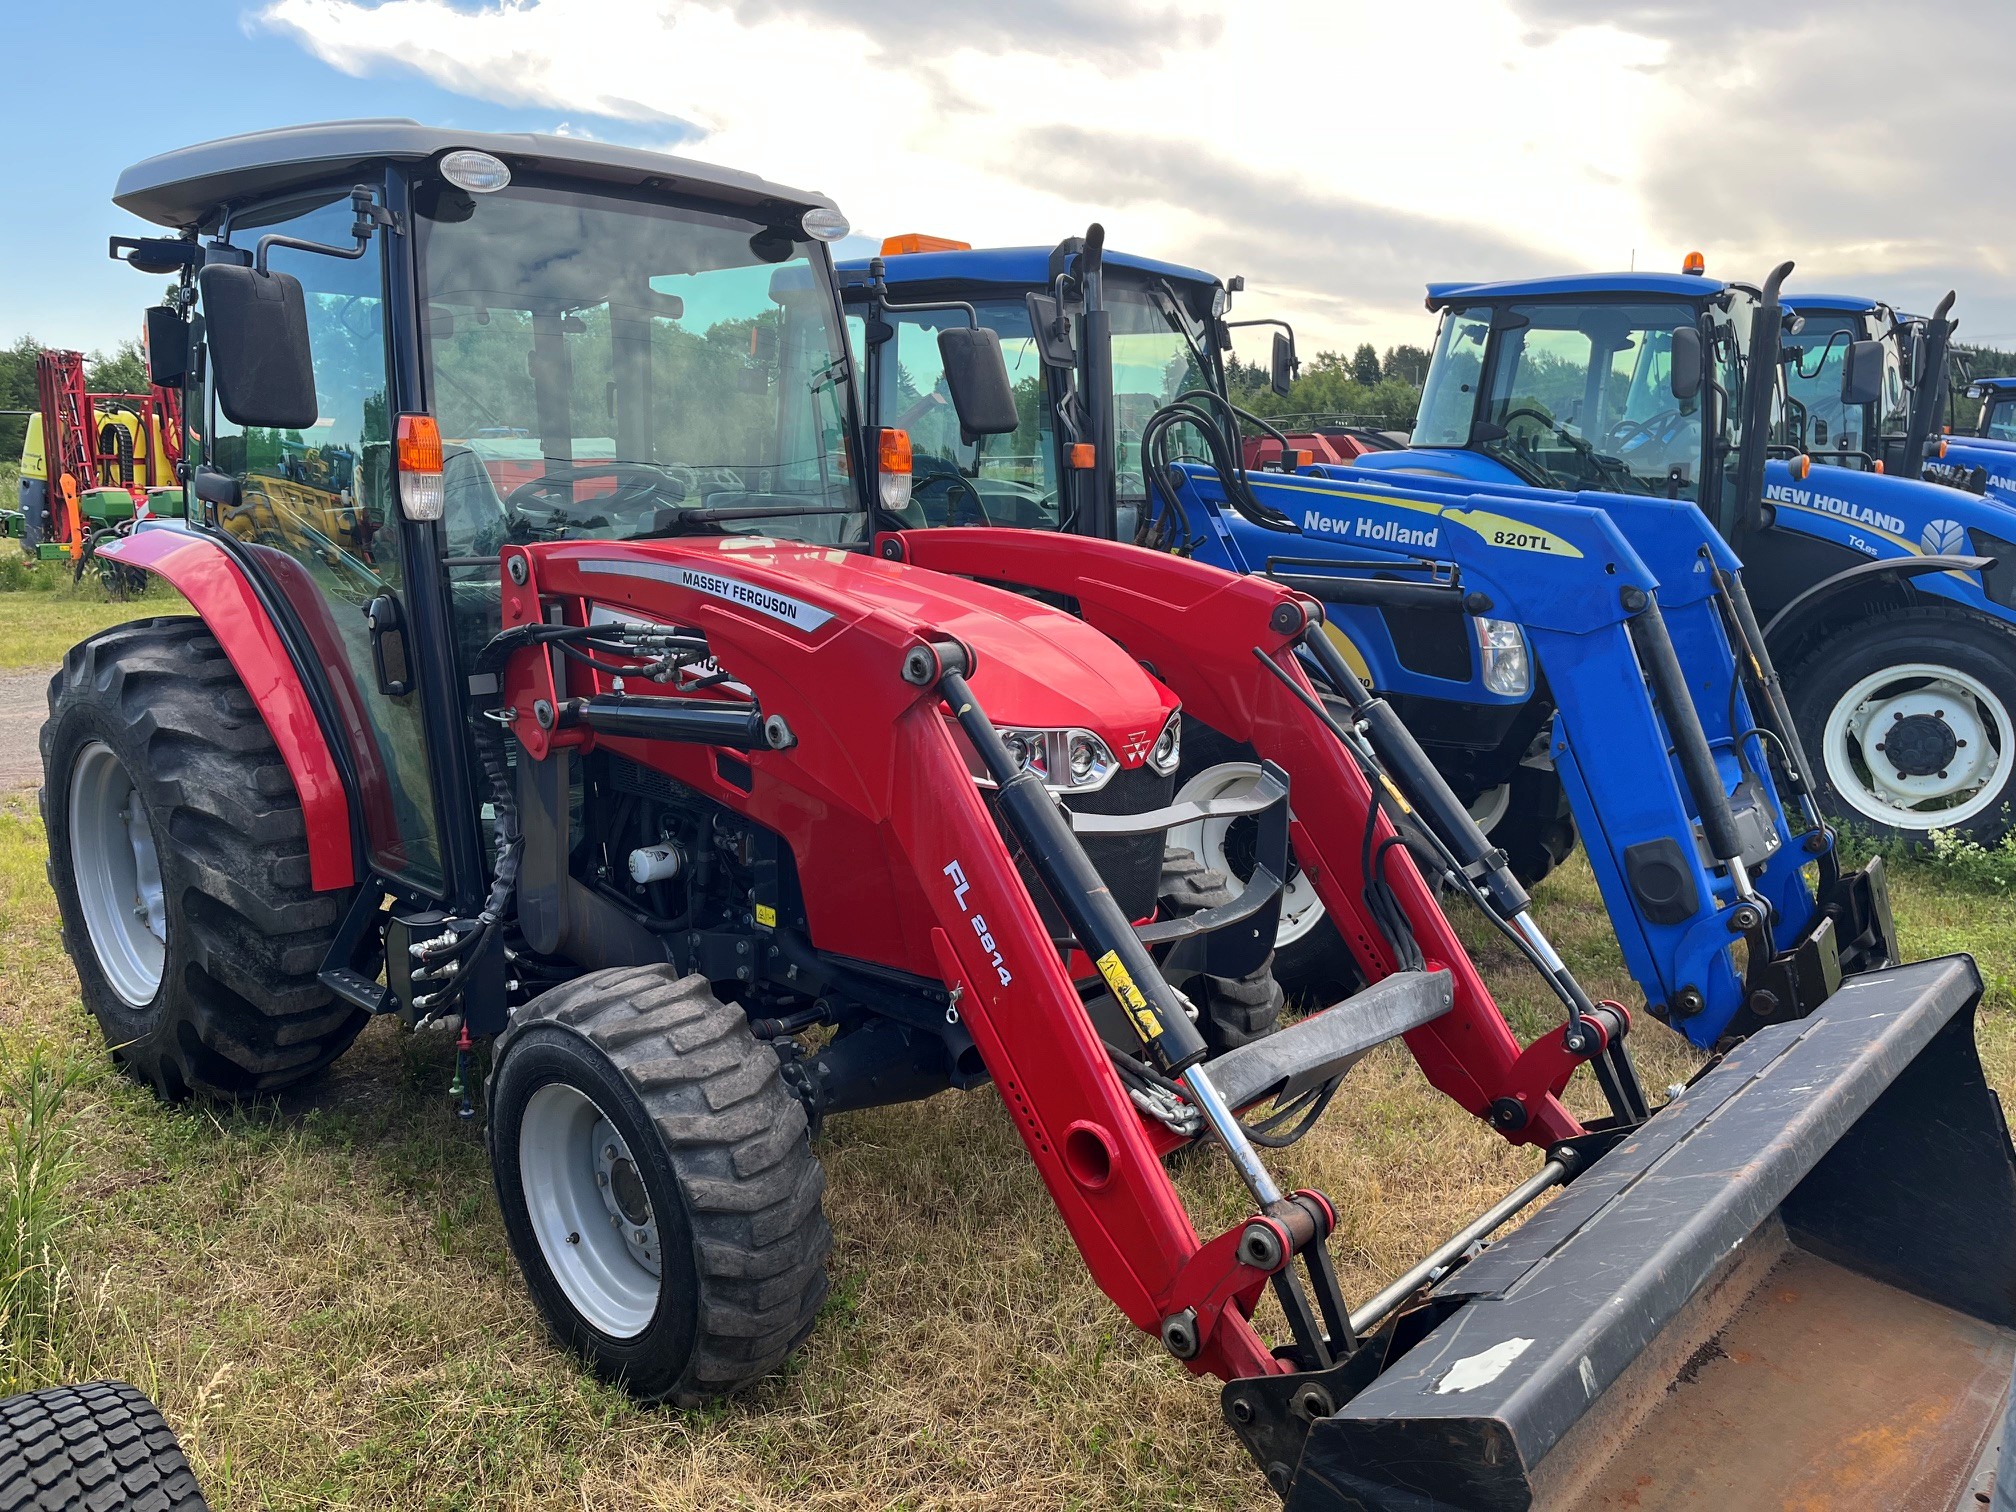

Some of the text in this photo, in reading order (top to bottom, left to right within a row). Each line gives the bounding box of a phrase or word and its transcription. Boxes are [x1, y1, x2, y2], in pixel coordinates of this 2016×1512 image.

[1303, 510, 1439, 548] New Holland
[1766, 484, 1906, 535] NEW HOLLAND
[1494, 531, 1552, 550] 820TL
[682, 571, 797, 619] MASSEY FERGUSON
[943, 859, 1013, 987] FL 2814
